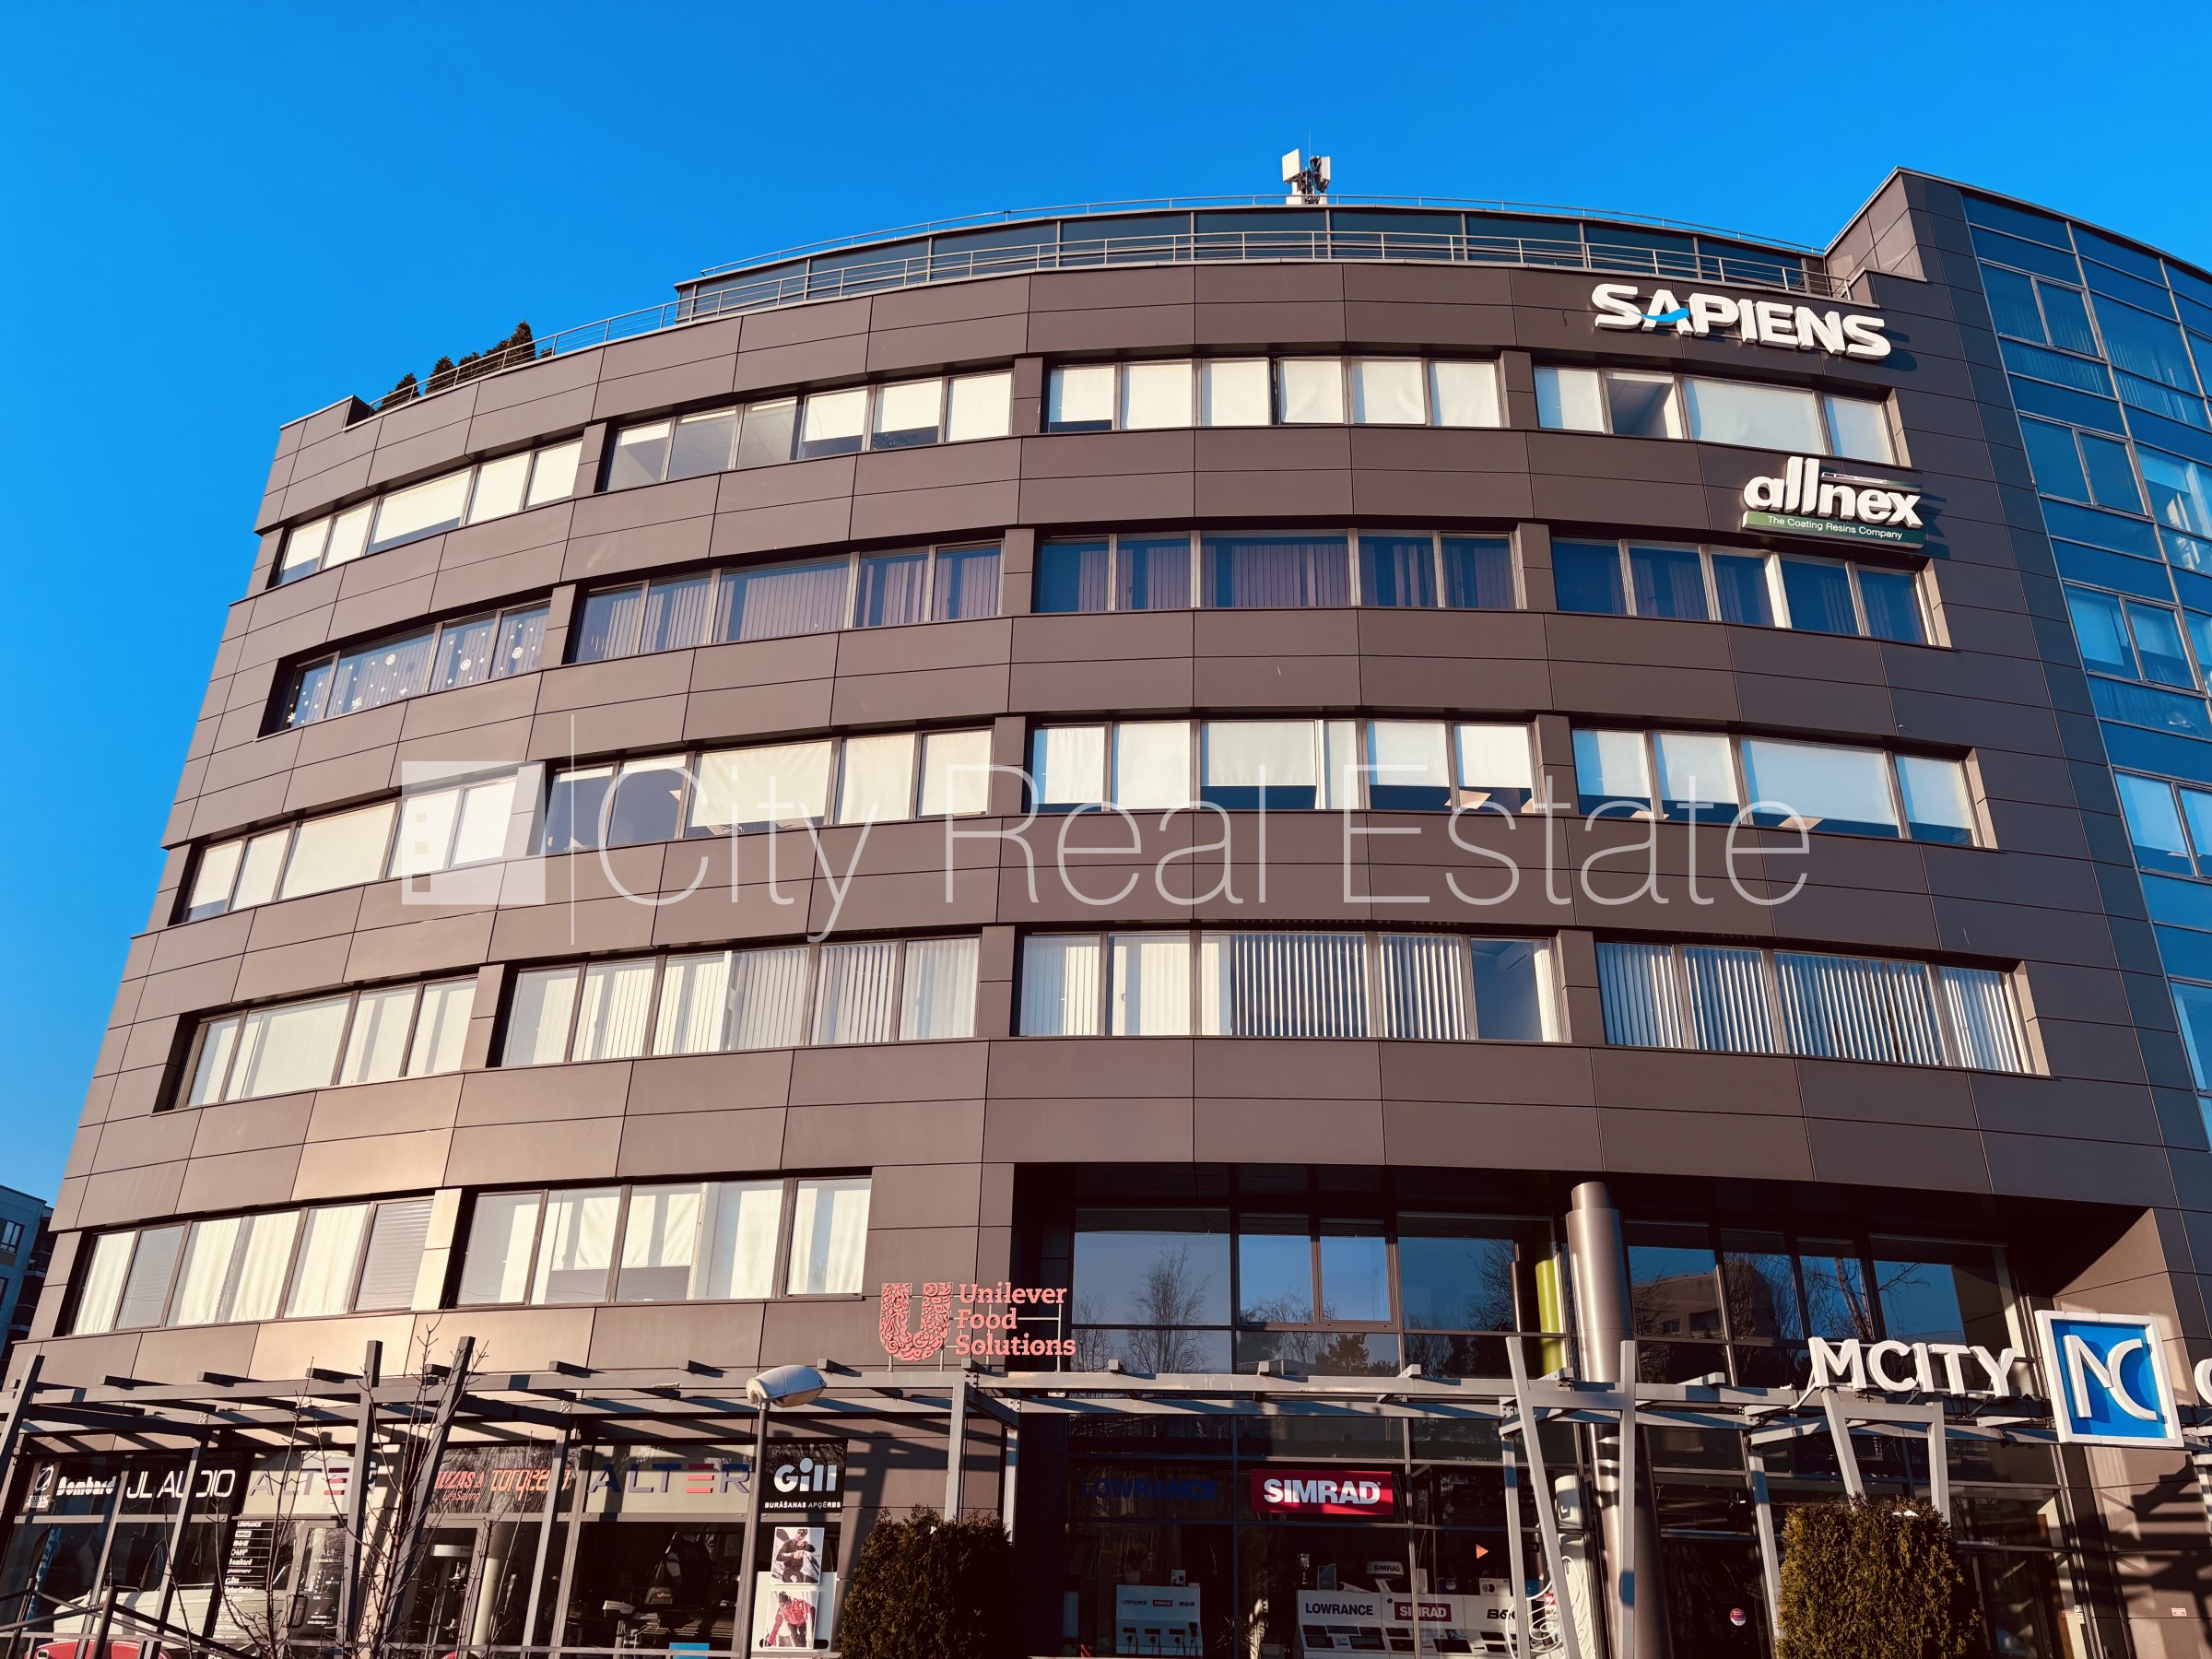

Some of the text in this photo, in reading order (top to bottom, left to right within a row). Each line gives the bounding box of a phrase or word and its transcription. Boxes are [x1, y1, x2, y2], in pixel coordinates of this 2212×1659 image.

[1591, 283, 1891, 359] SAPIENS
[1743, 456, 1924, 528] allnex
[1767, 515, 1903, 540] The Coating Resins Company
[959, 1282, 1067, 1304] Unilever
[957, 1308, 1017, 1330] Food
[955, 1333, 1077, 1357] Solutions
[1808, 1336, 2018, 1397] MCITY
[56, 1476, 117, 1496] Bombard
[126, 1470, 153, 1499] JL
[587, 1463, 750, 1494] ALTER
[773, 1457, 838, 1493] Gill
[1080, 1477, 1220, 1500] LOWRANCE
[1264, 1478, 1382, 1504] SIMRAD
[1373, 1564, 1401, 1572] SIMRAD
[1305, 1603, 1374, 1616] LOWRANCE
